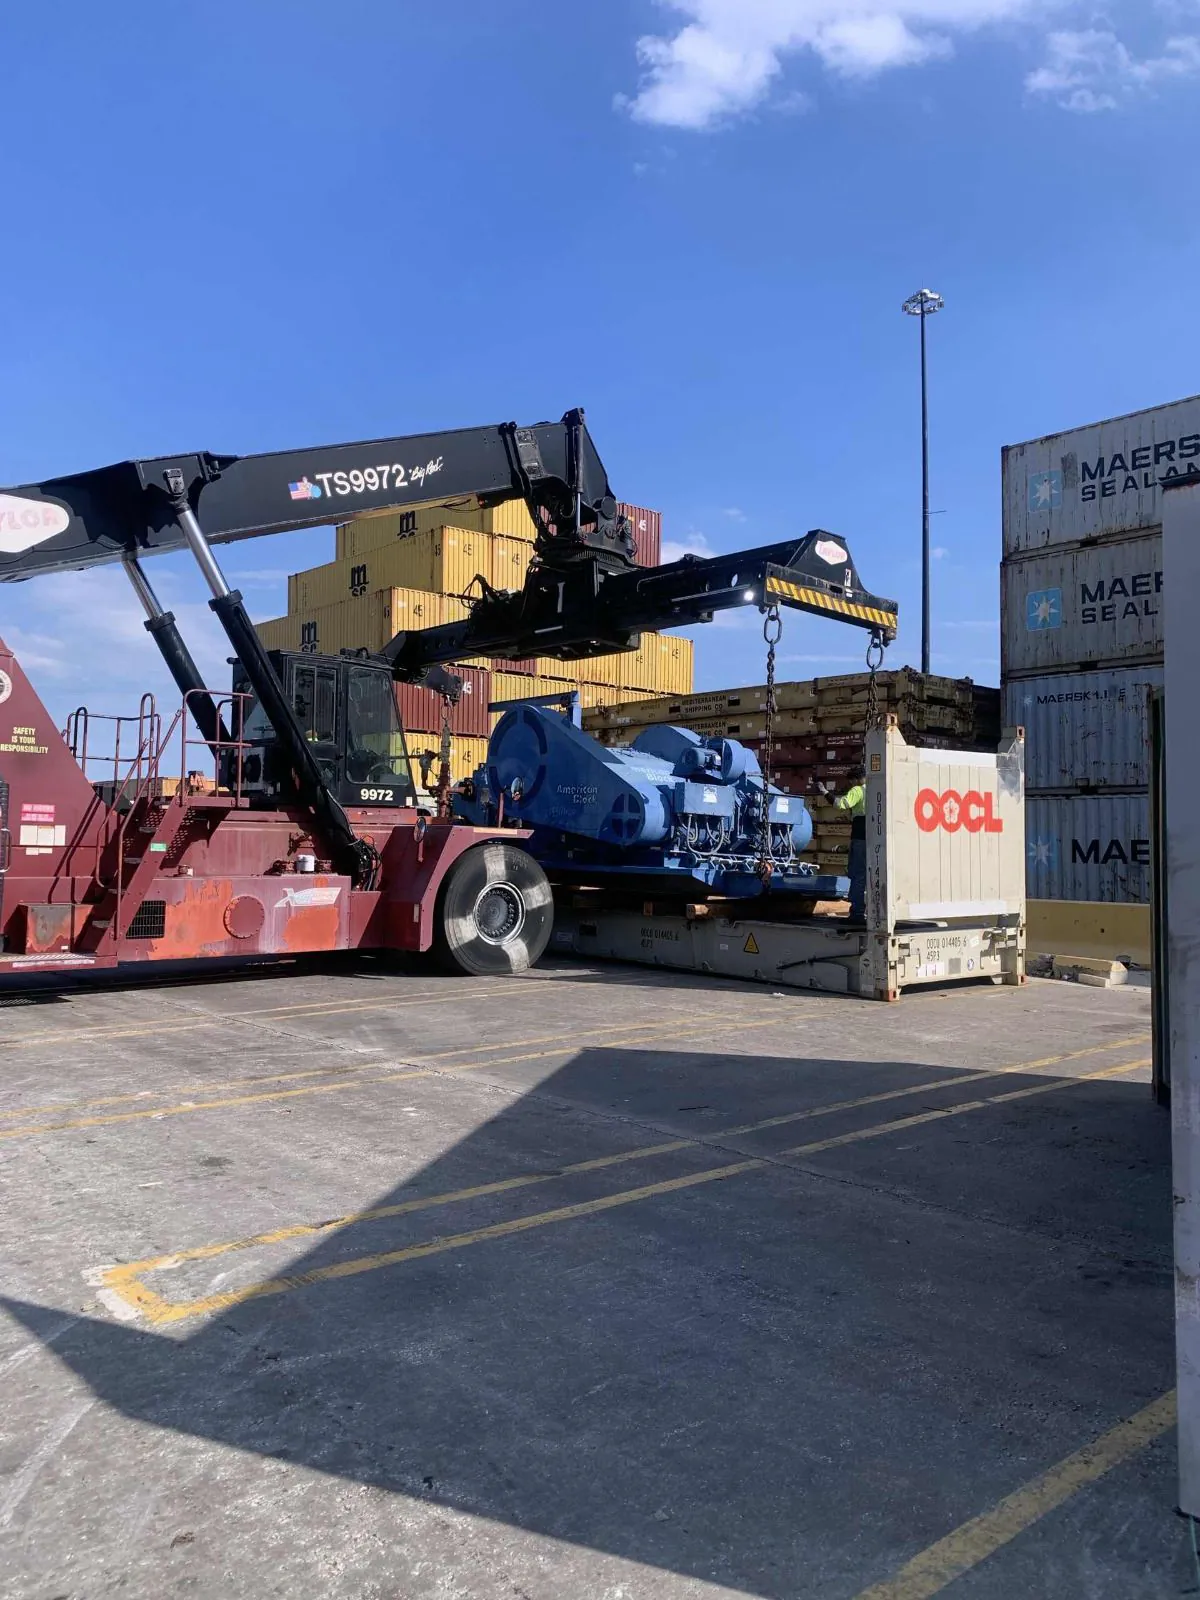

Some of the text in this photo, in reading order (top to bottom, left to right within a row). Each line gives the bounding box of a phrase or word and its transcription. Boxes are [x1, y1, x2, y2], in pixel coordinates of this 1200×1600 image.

[1081, 433, 1200, 482] MAERS
[316, 464, 408, 497] TS9972
[1081, 600, 1158, 625] SEAL
[1036, 691, 1091, 705] MAERSK
[13, 726, 36, 735] SAFETY
[0, 743, 49, 754] RESPONSIBILITY
[20, 736, 36, 745] YOUR
[361, 788, 393, 801] 9972
[914, 788, 1003, 833] OOCL
[1072, 839, 1150, 865] MAE
